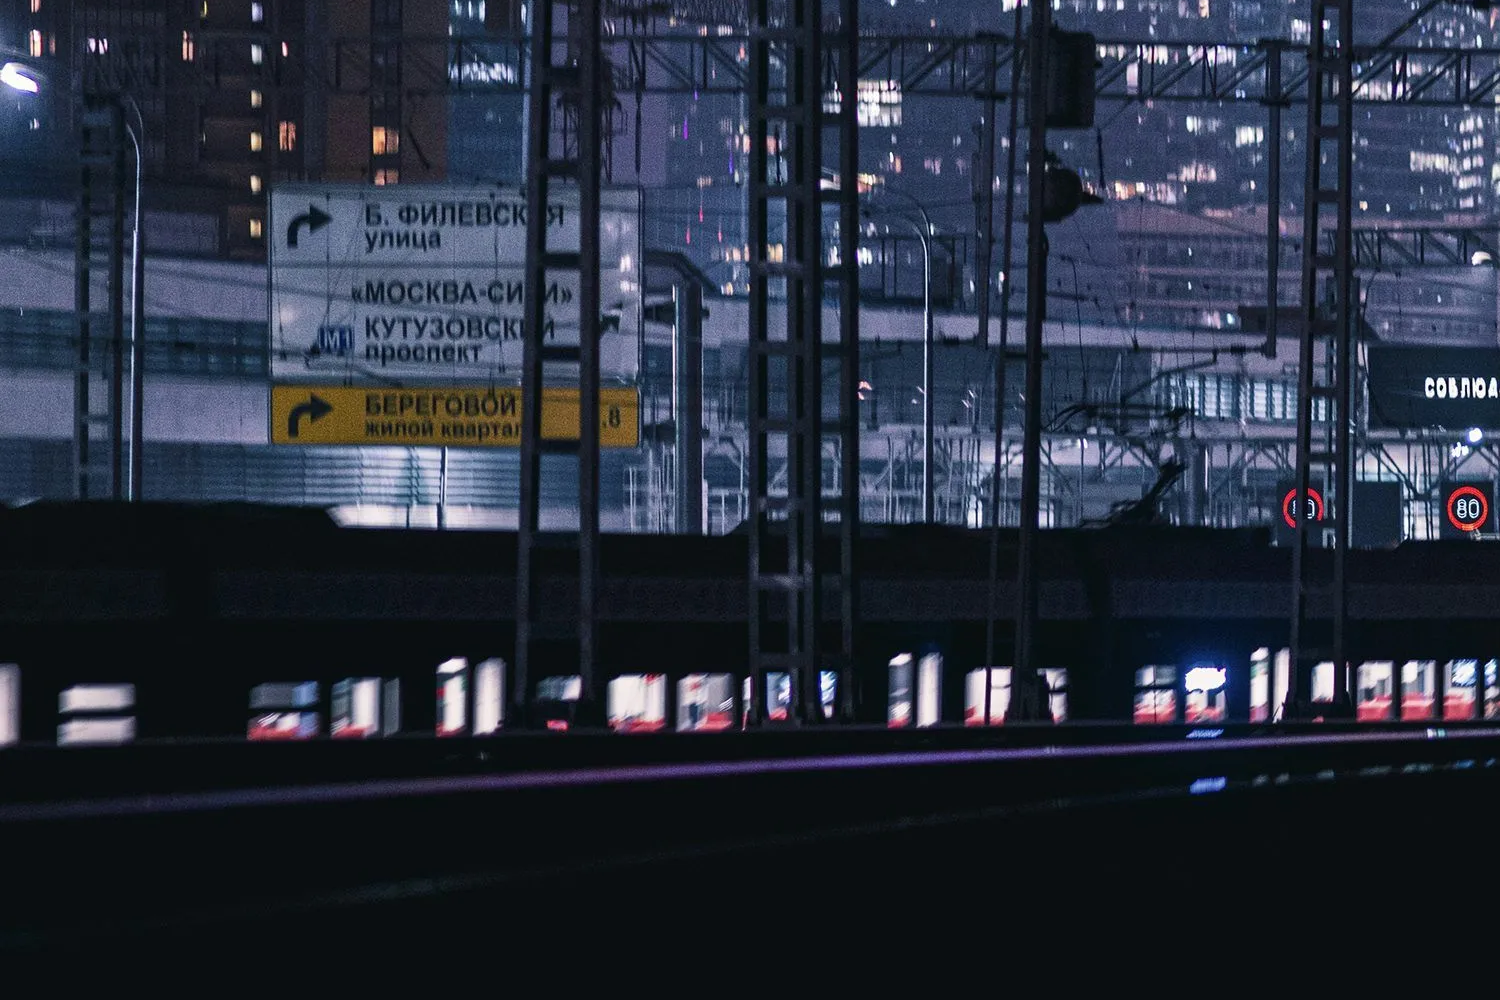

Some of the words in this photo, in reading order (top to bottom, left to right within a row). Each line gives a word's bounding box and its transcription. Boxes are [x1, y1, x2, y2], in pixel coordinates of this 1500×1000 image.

[398, 204, 564, 226] ФИЛЕВСКЯ
[365, 230, 441, 253] улица
[351, 280, 572, 304] «МОСКВА-СИИ»
[365, 315, 555, 339] КУТУЗОВСКЙ
[365, 343, 481, 367] проспект
[365, 419, 434, 437] жилой
[1457, 498, 1480, 519] 80
